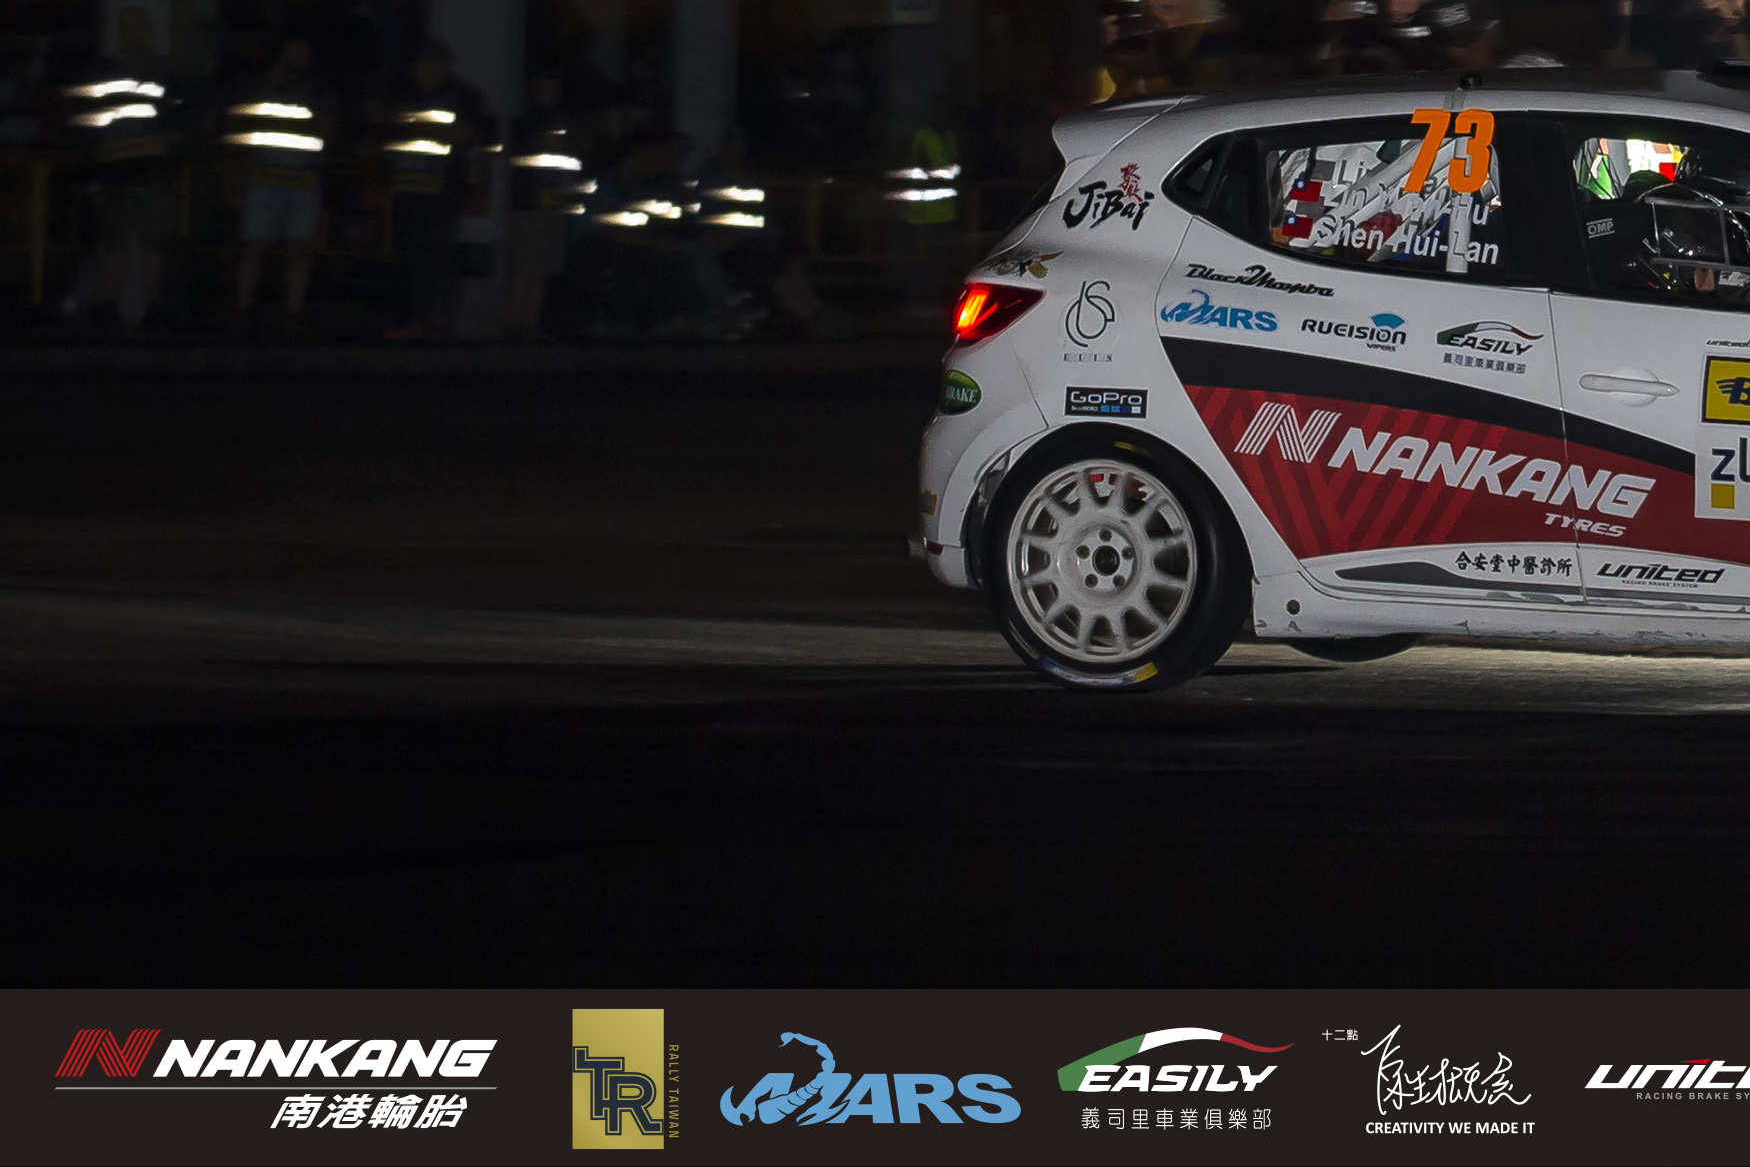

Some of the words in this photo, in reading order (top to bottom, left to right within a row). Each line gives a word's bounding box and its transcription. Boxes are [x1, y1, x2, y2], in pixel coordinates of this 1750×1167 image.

[1403, 108, 1495, 193] 73
[1317, 214, 1384, 251] Shen
[1587, 221, 1614, 235] OMP
[1184, 263, 1335, 298] BlackMamba
[1160, 296, 1278, 332] MARS
[1447, 333, 1533, 356] EASILY
[944, 385, 978, 413] RAKE
[1070, 391, 1143, 405] GoPro
[1328, 426, 1657, 519] NANKANG
[1545, 512, 1627, 538] TYRES
[1596, 562, 1726, 584] united
